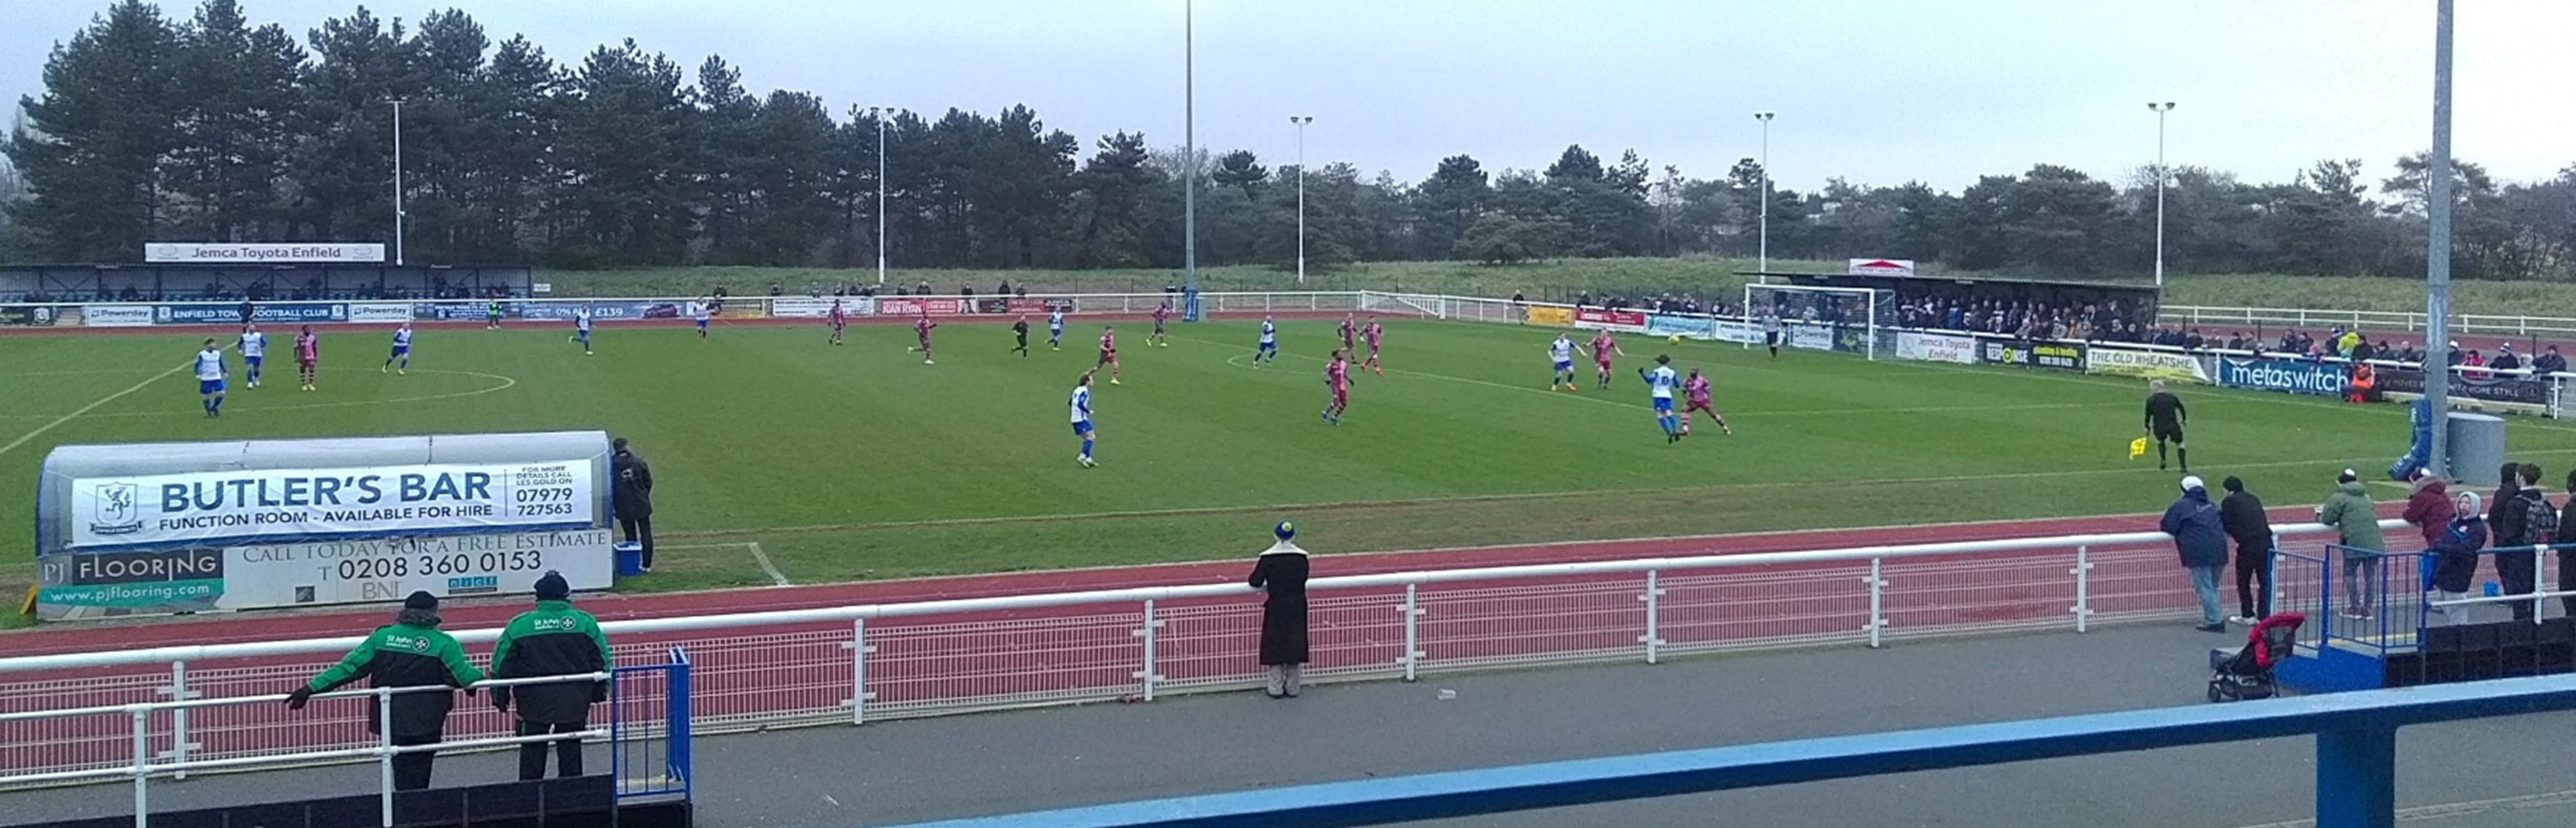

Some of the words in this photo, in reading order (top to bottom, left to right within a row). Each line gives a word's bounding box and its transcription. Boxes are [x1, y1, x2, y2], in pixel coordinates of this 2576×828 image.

[192, 247, 237, 258] Jemca
[241, 247, 289, 261] Toyota
[292, 247, 341, 258] Enfield
[101, 309, 148, 318] Powerday
[174, 310, 215, 319] ENFIELD
[218, 310, 240, 318] TOW
[254, 307, 300, 318] FOOTBALL
[303, 309, 328, 317] CLUB
[363, 307, 407, 317] Powerday
[595, 307, 624, 316] £139
[902, 304, 922, 314] RYAN
[1917, 336, 1943, 348] Jemca
[1945, 338, 1970, 351] Toyota
[1929, 349, 1958, 362] Enfield
[2092, 351, 2110, 362] THE
[2113, 353, 2132, 364] OLD
[2135, 354, 2194, 370] WHEATSHE
[2231, 363, 2348, 392] metaswitch
[162, 475, 381, 513] BUTLER'S
[401, 472, 490, 502] BAR
[516, 487, 573, 502] 07979
[160, 514, 249, 531] FUNCTION
[255, 512, 308, 524] ROOM
[323, 507, 413, 523] AVAILABLE
[419, 507, 450, 518] FOR
[456, 504, 493, 517] HIRE
[516, 503, 572, 517] 727563
[243, 547, 295, 563] CALL
[303, 541, 382, 559] TODAY
[436, 540, 450, 553] A
[457, 536, 508, 552] FREE
[516, 531, 606, 550] ESTIMATE
[44, 563, 64, 583] PJ
[80, 549, 217, 582] FLOORING
[317, 566, 332, 581] T
[339, 557, 408, 580] 0208
[419, 553, 470, 576] 360
[480, 550, 542, 572] 0153
[50, 584, 210, 602] www.pjflooring.com
[396, 635, 412, 644] John
